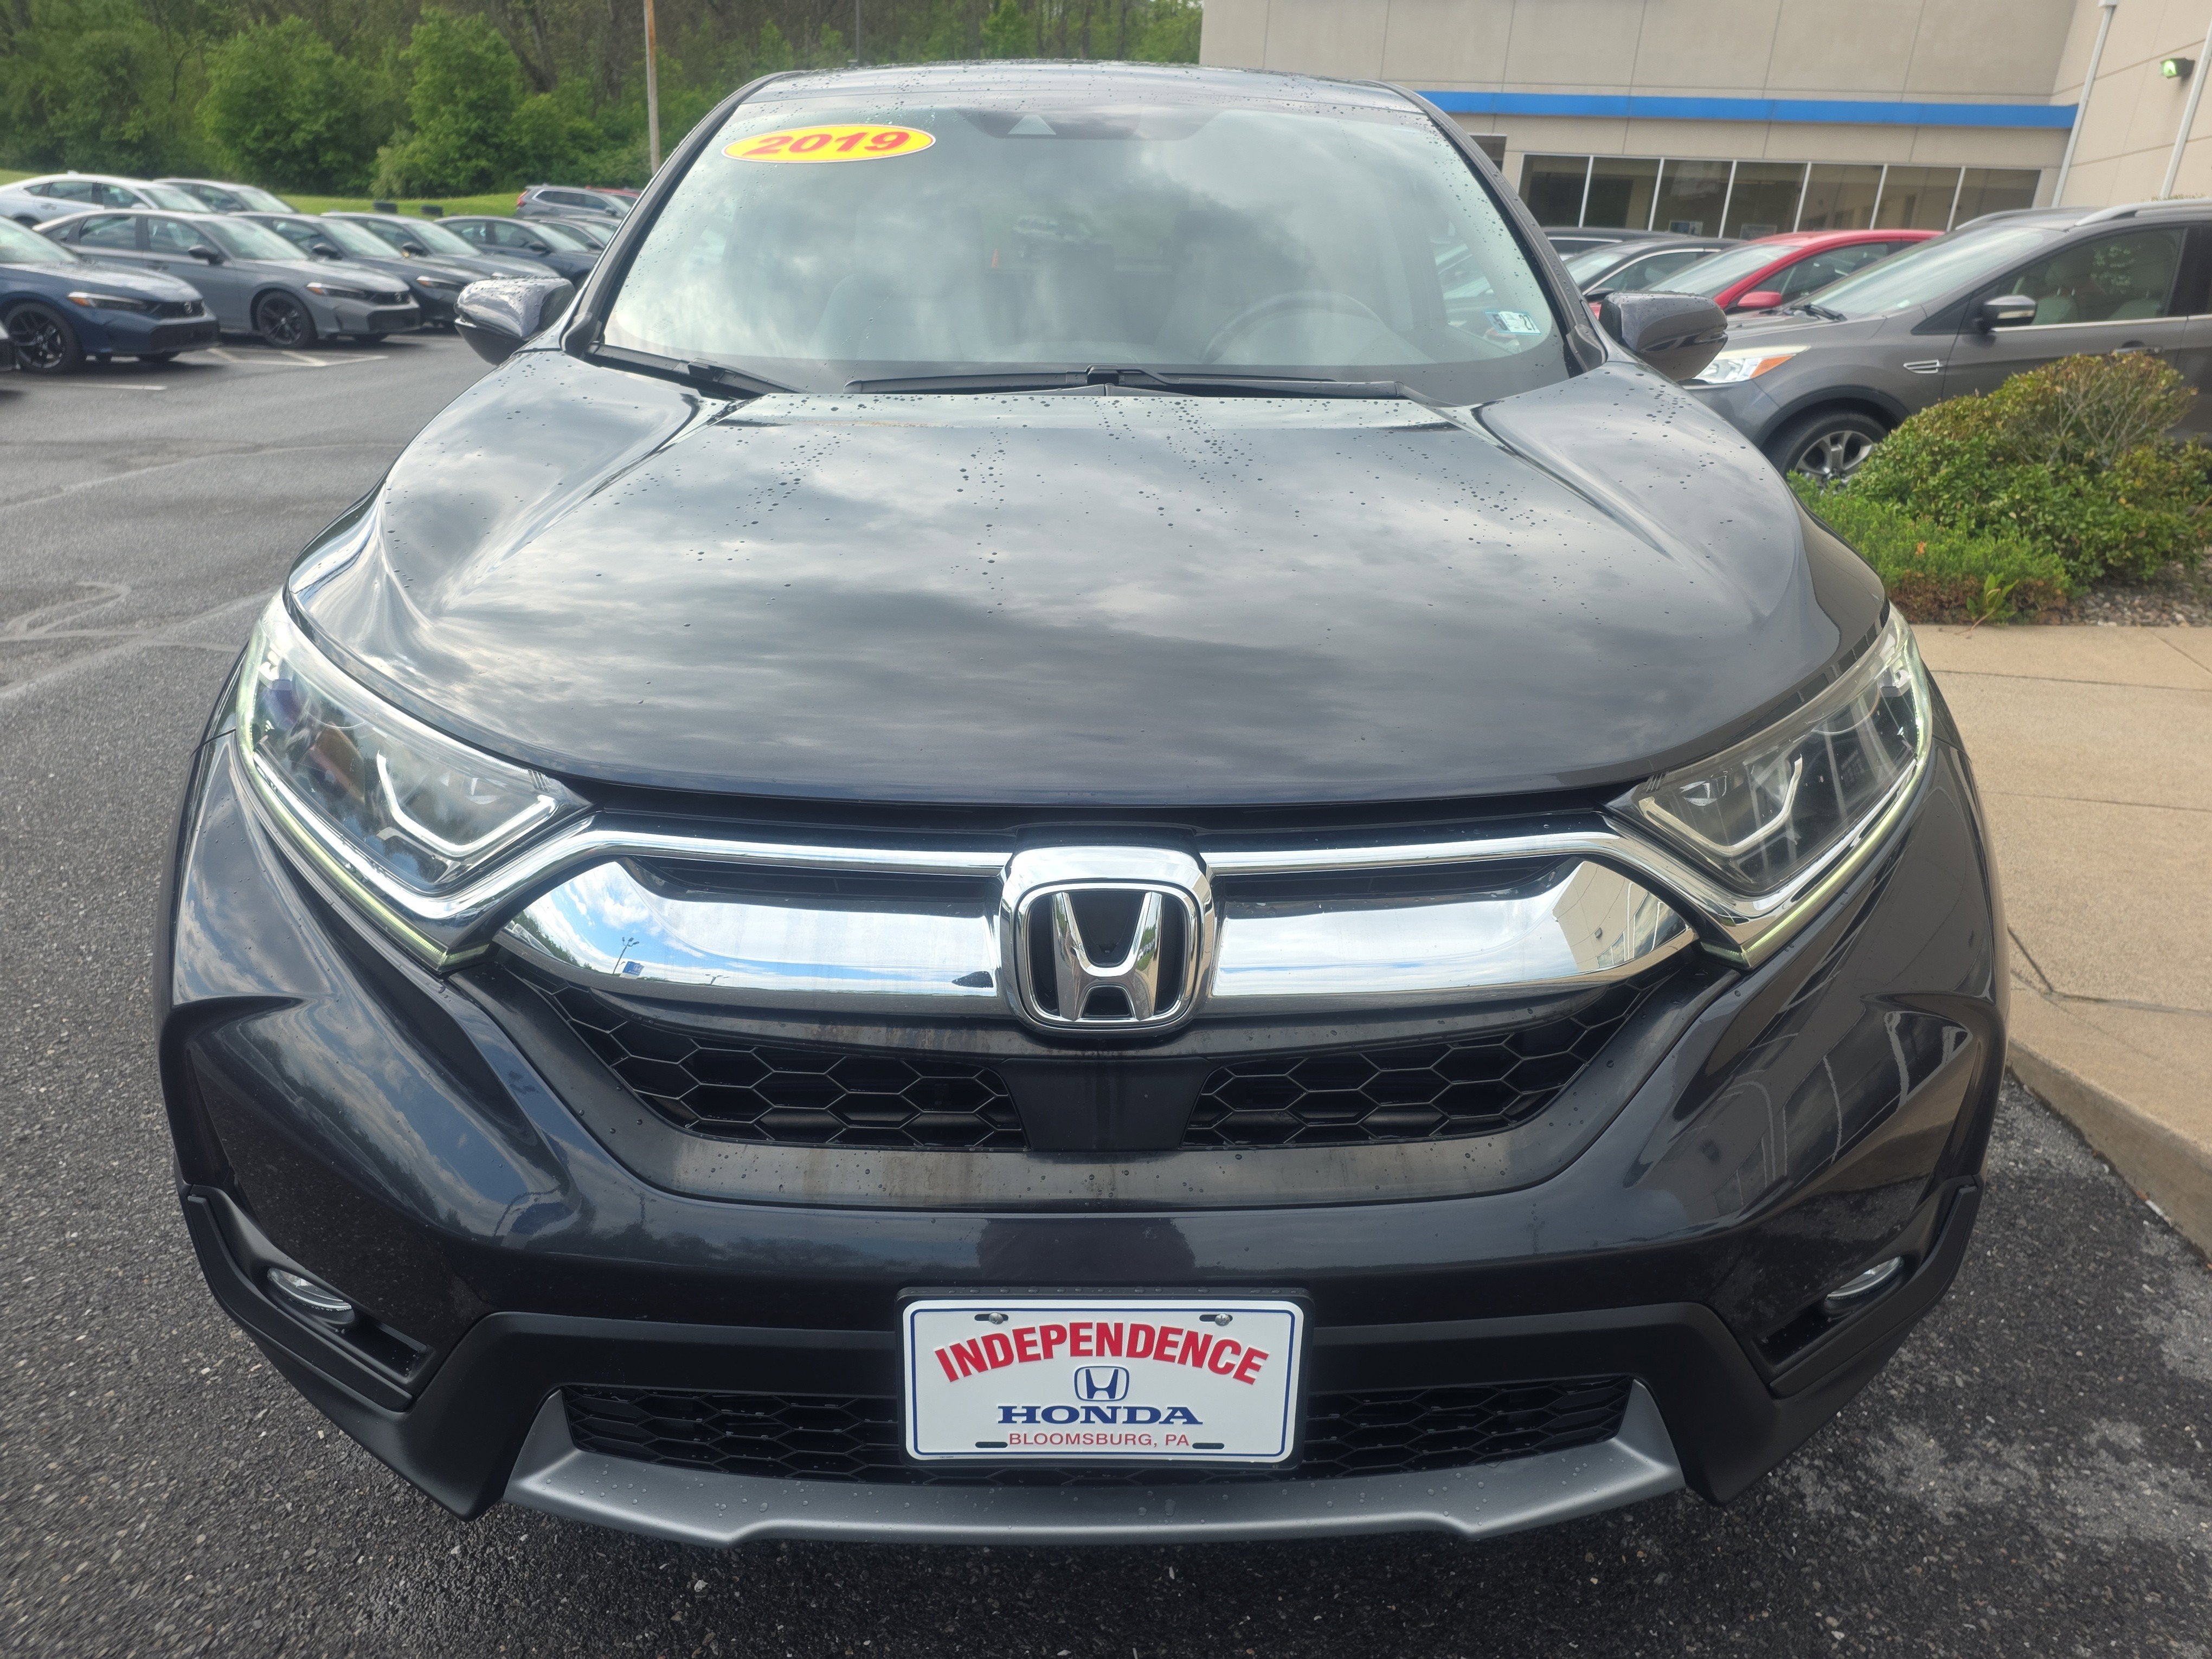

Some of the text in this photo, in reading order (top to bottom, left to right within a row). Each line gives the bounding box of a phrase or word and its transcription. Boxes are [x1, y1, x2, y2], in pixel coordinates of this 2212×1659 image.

[743, 132, 912, 156] 2019
[934, 1322, 1269, 1385] INDEPENDENCE
[997, 1406, 1203, 1425] HONDA
[1009, 1433, 1189, 1448] BLOOMSBURG, PA
